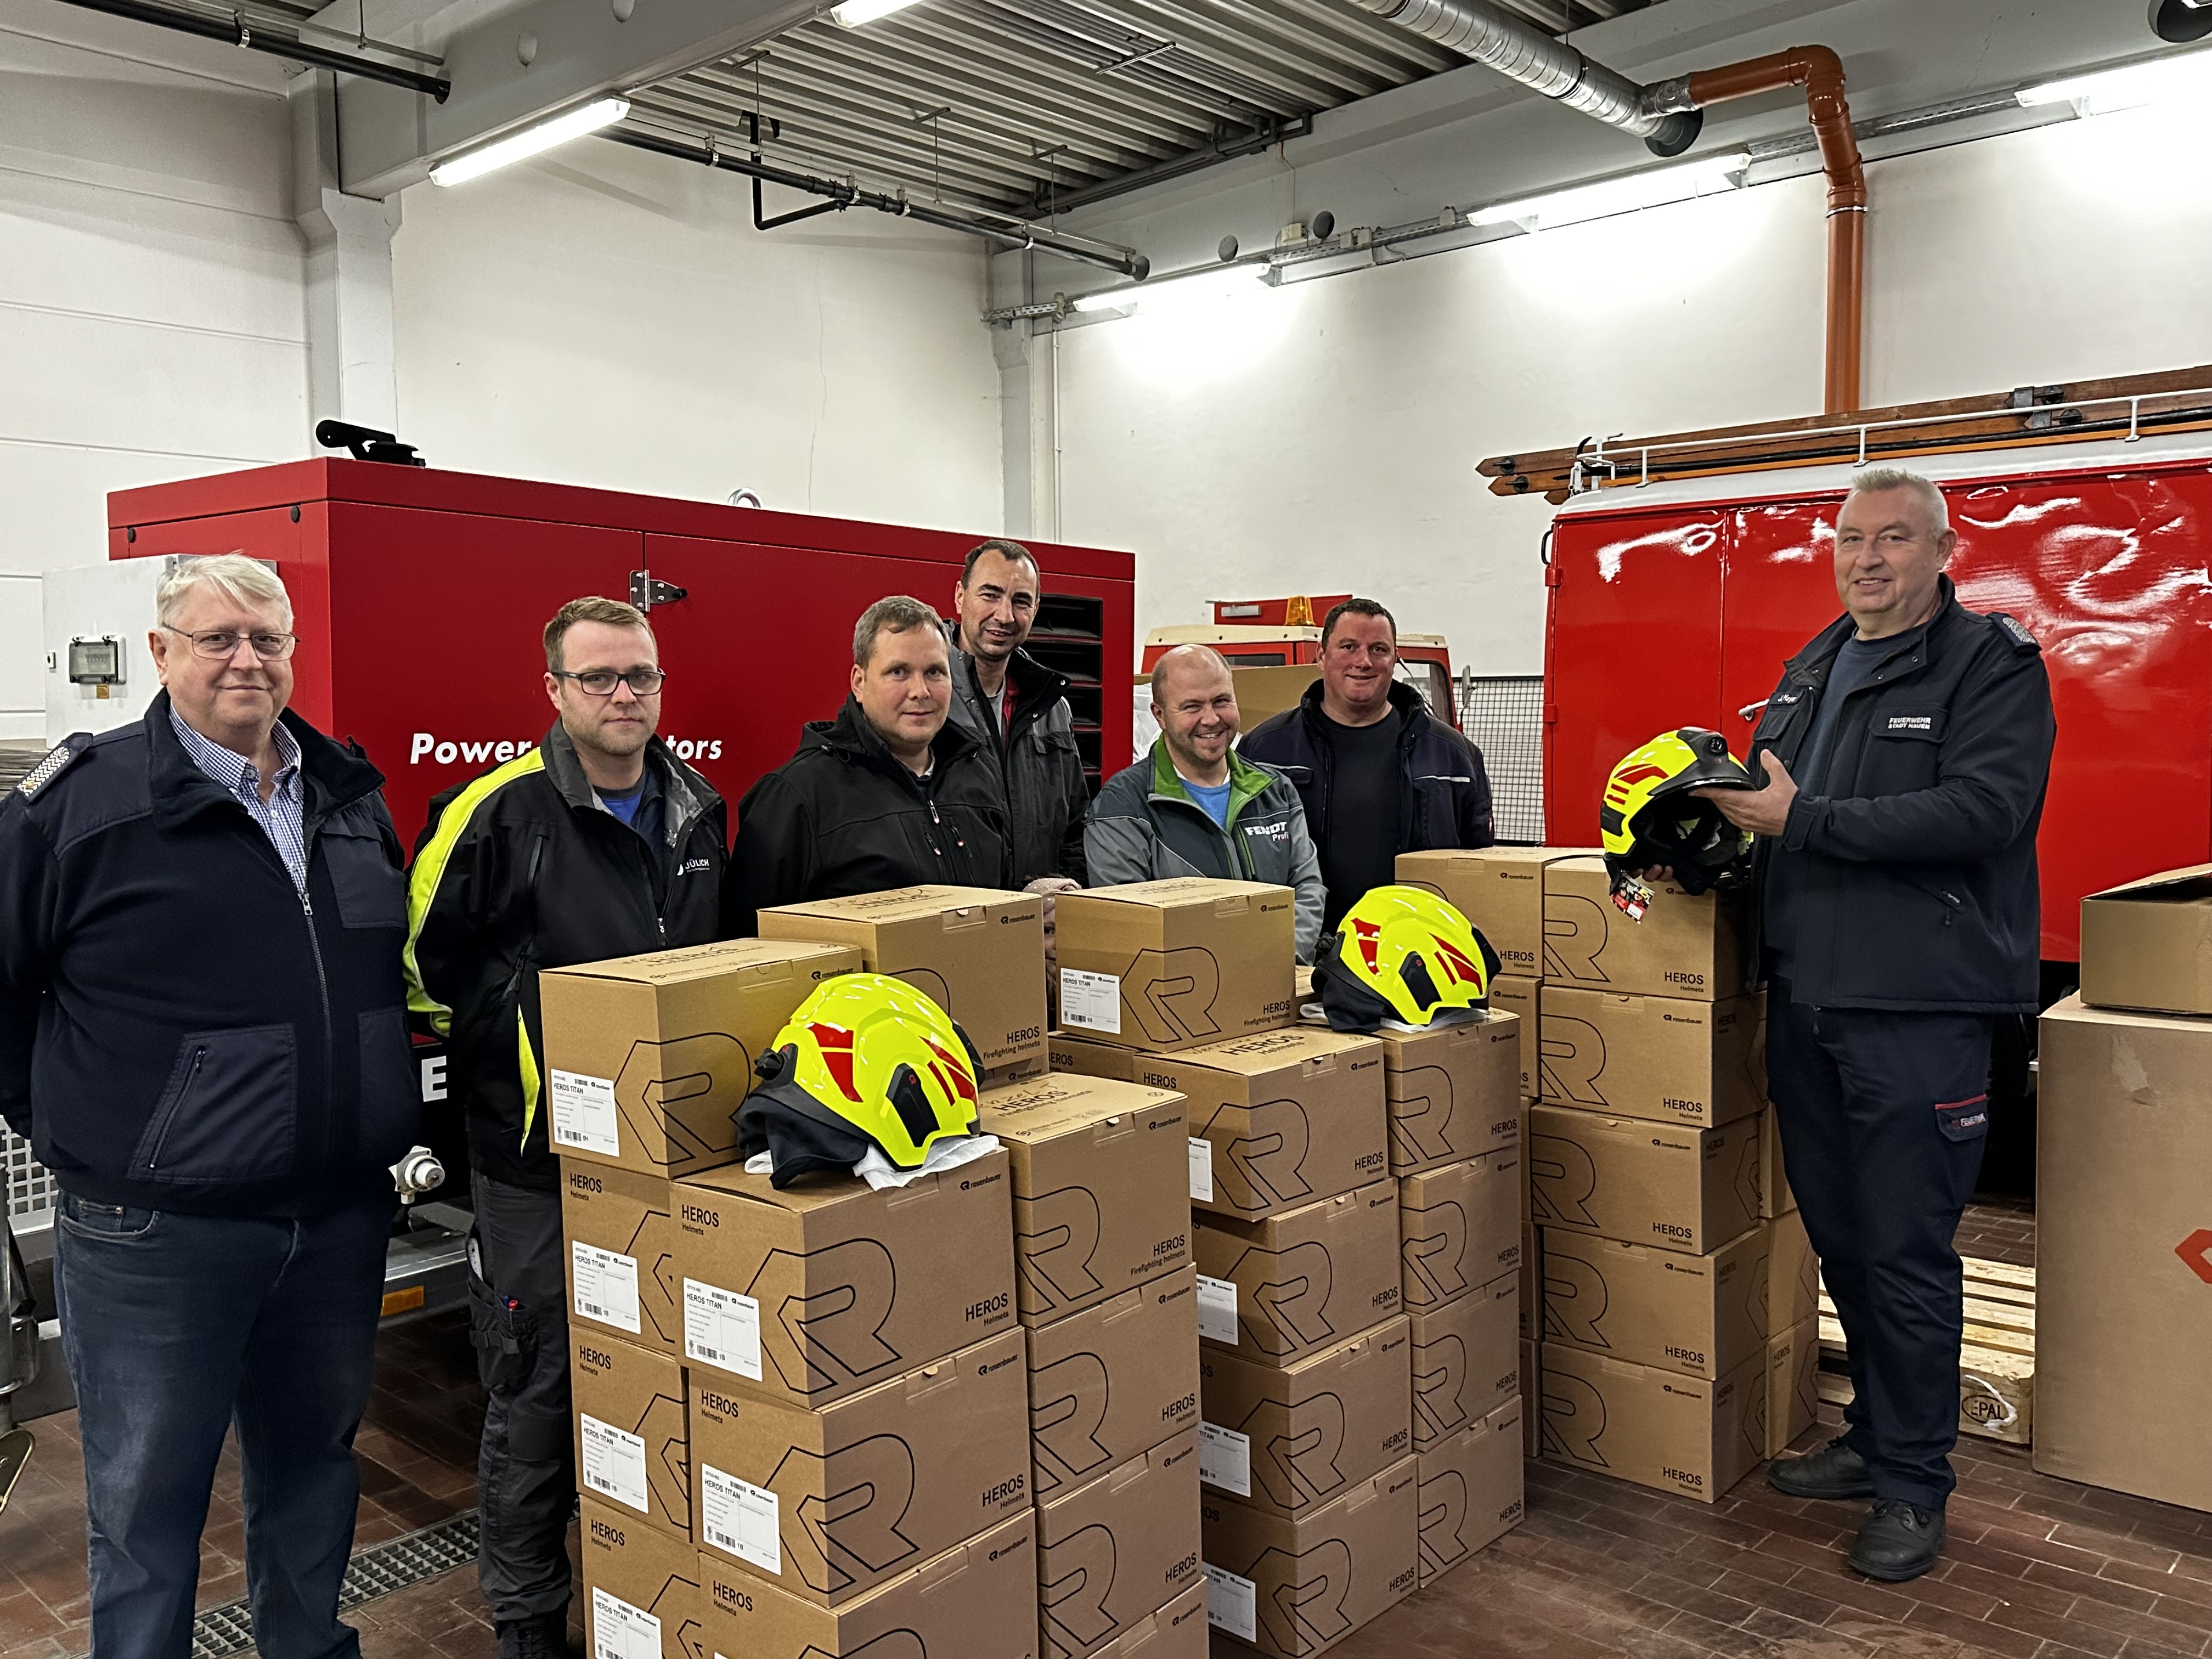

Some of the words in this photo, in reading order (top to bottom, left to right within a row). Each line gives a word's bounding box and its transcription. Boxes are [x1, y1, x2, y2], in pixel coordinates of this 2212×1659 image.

[410, 733, 533, 764] Power
[1245, 821, 1287, 836] FENDT
[1272, 831, 1289, 842] Profi
[685, 859, 709, 869] JÜLICH
[1500, 951, 1534, 962] HEROS
[822, 968, 854, 978] rosenbauer
[1664, 972, 1704, 985] HEROS
[1263, 1000, 1290, 1014] HEROS
[1244, 1017, 1271, 1026] Firefighting
[1272, 1012, 1290, 1022] helmets
[1007, 1026, 1040, 1043] HEROS
[984, 1045, 1015, 1059] Firefighting
[1017, 1040, 1040, 1053] helmets
[1219, 1035, 1305, 1055] HEROS
[1050, 1052, 1073, 1066] EROS
[1143, 1072, 1177, 1088] HEROS
[571, 1085, 583, 1094] TITAN
[992, 1091, 1068, 1110] HEROS
[997, 1101, 1057, 1117] Firefighting
[1057, 1091, 1093, 1103] helmets
[1663, 1098, 1702, 1112] HEROS
[1491, 1119, 1517, 1136] HEROS
[1355, 1152, 1383, 1170] HEROS
[570, 1173, 602, 1193] HEROS
[970, 1173, 1002, 1189] rosenbauer
[571, 1190, 589, 1201] Helmets
[682, 1204, 719, 1228] HEROS
[682, 1223, 704, 1236] Helmets
[1652, 1222, 1692, 1238] HEROS
[1153, 1234, 1185, 1257] HEROS
[1498, 1245, 1519, 1262] HEROS
[591, 1259, 605, 1269] TITAN
[1131, 1256, 1161, 1276] Firefighting
[1160, 1249, 1185, 1266] helmets
[706, 1298, 721, 1310] TITAN
[1372, 1286, 1398, 1307] HEROS
[966, 1293, 1009, 1322] HEROS
[984, 1310, 1009, 1326] Helmets
[579, 1345, 611, 1370] HEROS
[989, 1354, 1018, 1373] rosenbauer
[1665, 1346, 1705, 1364] HEROS
[579, 1363, 598, 1376] Helmets
[1496, 1371, 1516, 1391] HEROS
[701, 1390, 738, 1418] HEROS
[1162, 1393, 1195, 1421] HEROS
[1971, 1400, 2005, 1420] EPAL
[702, 1408, 723, 1425] Helmets
[600, 1434, 613, 1445] TITAN
[1383, 1429, 1407, 1451] HEROS
[1663, 1467, 1702, 1486] HEROS
[725, 1487, 741, 1500] TITAN
[982, 1474, 1024, 1508] HEROS
[1000, 1492, 1024, 1510] Helmets
[1499, 1499, 1521, 1522] HEROS
[591, 1519, 625, 1547] HEROS
[591, 1537, 611, 1551] Helmets
[998, 1536, 1028, 1556] rosenbauer
[1165, 1552, 1197, 1583] HEROS
[1390, 1567, 1414, 1591] HEROS
[714, 1581, 753, 1612] HEROS
[613, 1608, 628, 1622] TITAN
[714, 1599, 737, 1616] Helmets
